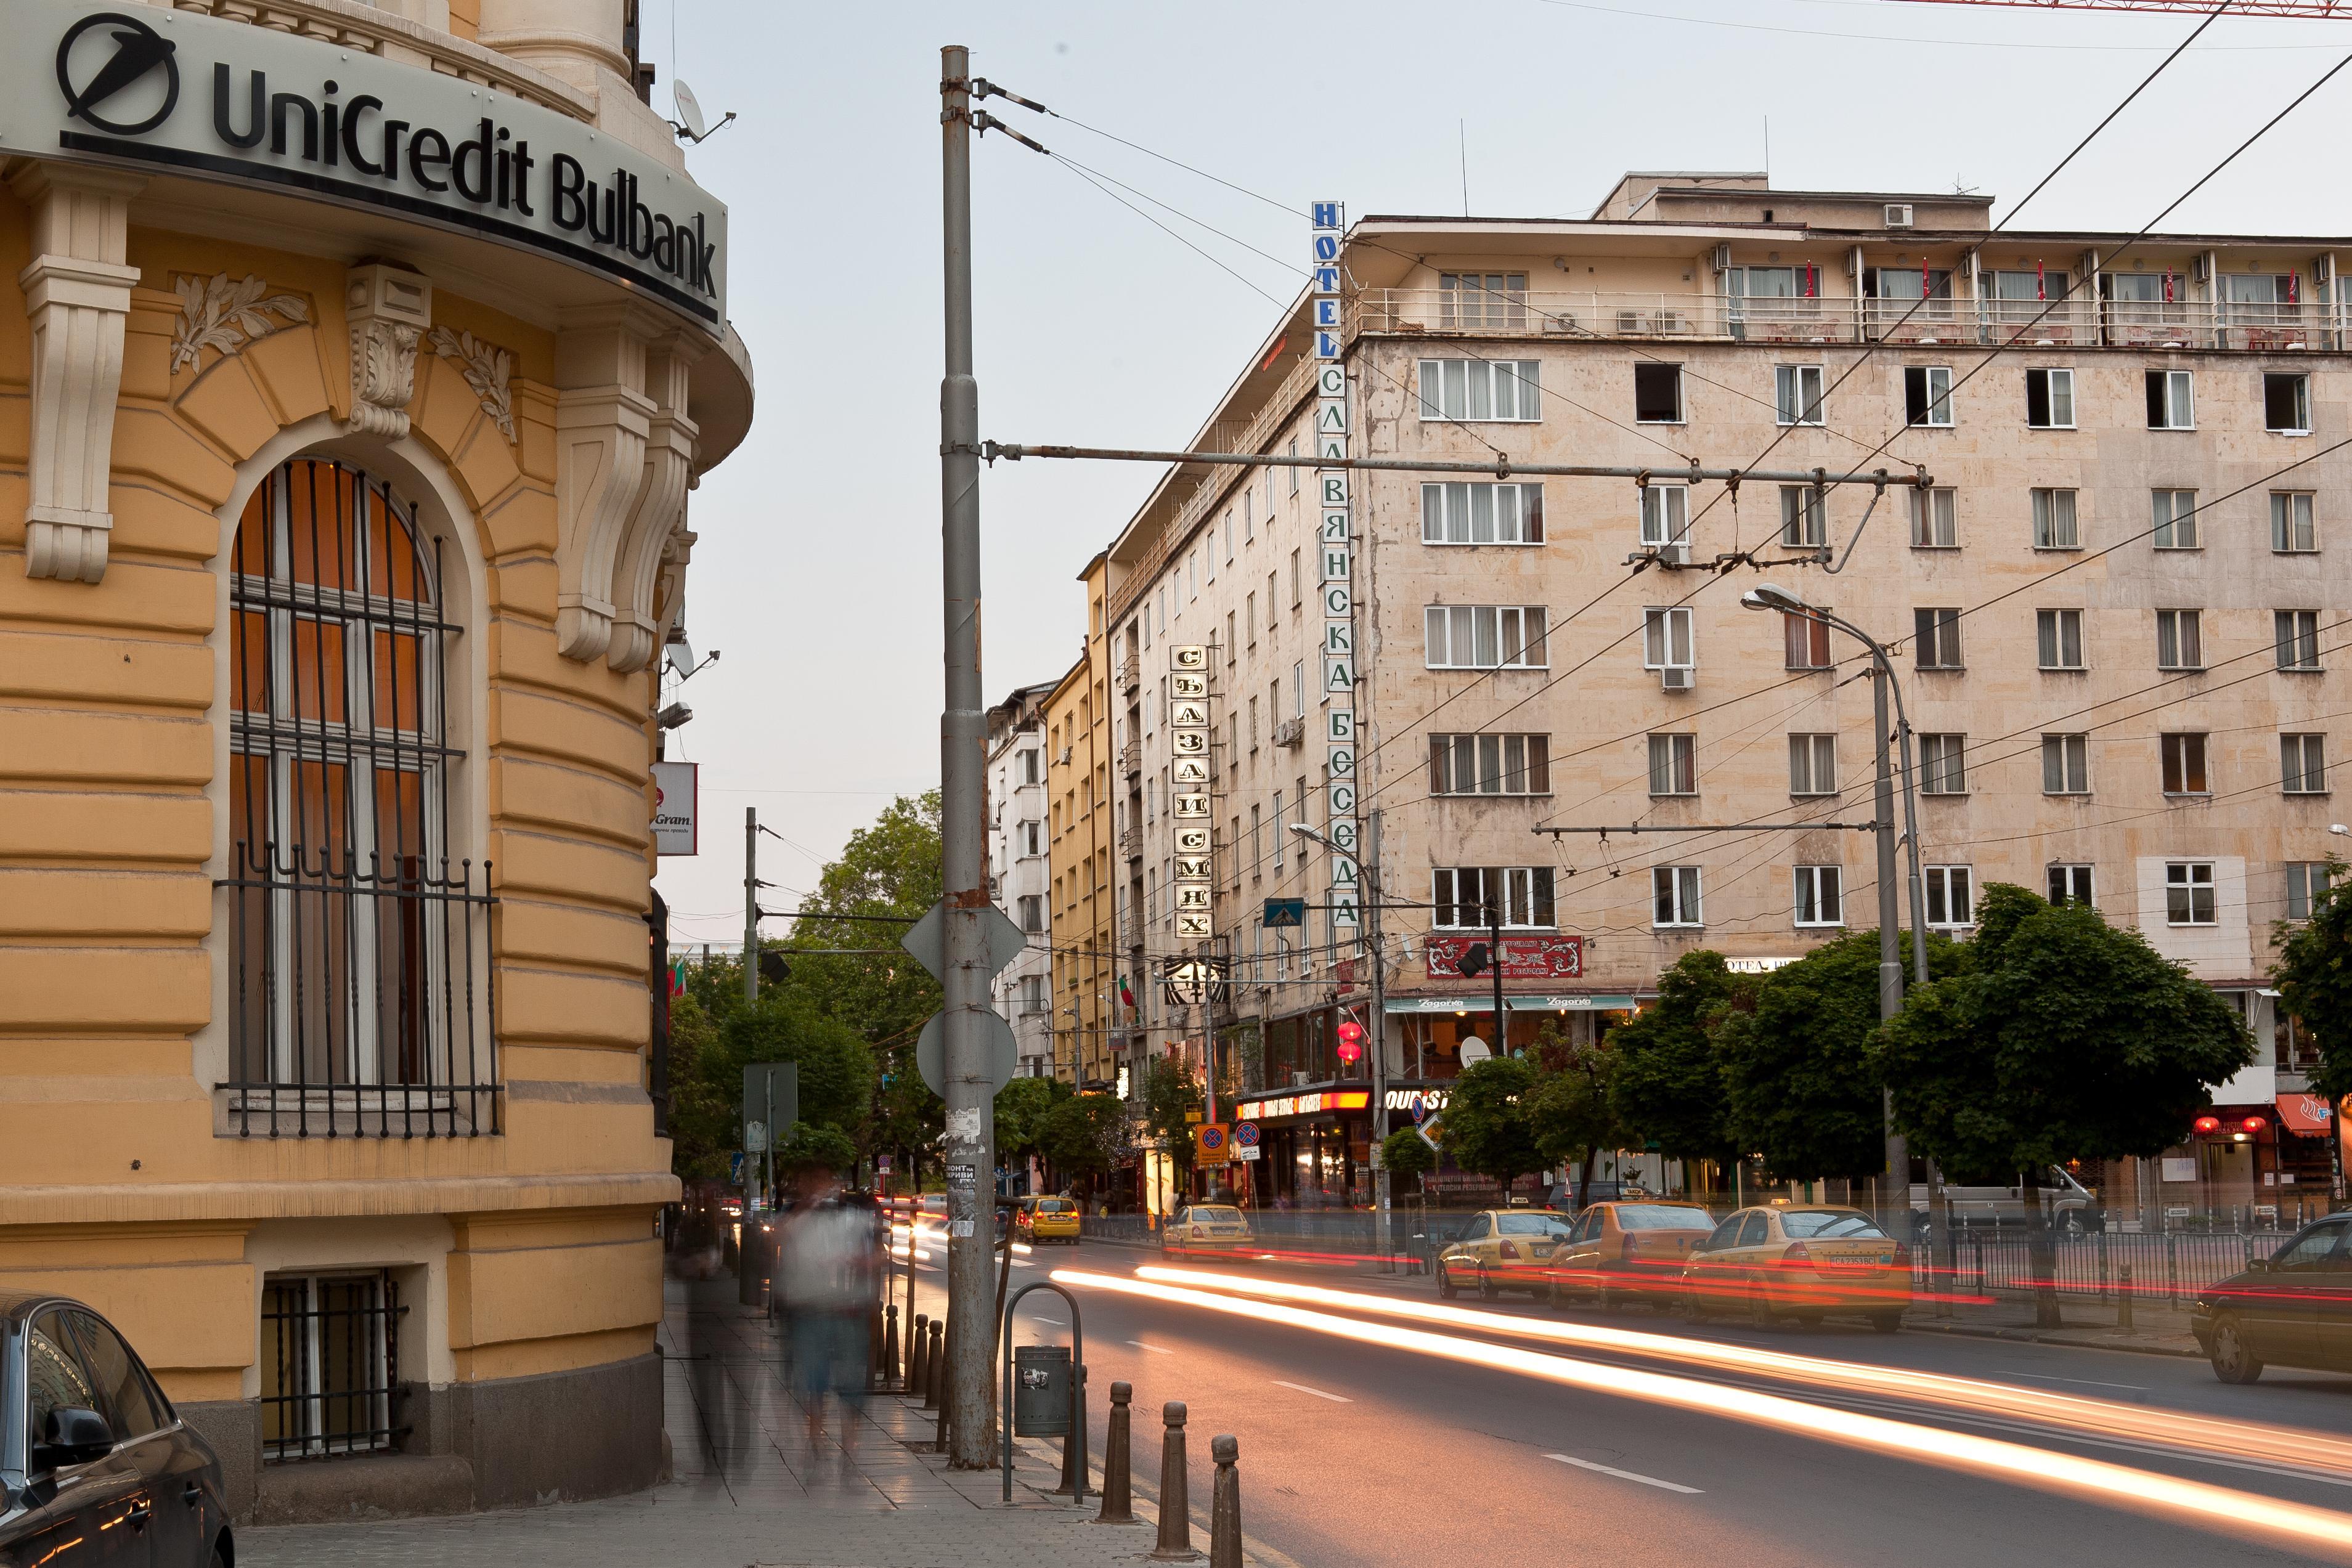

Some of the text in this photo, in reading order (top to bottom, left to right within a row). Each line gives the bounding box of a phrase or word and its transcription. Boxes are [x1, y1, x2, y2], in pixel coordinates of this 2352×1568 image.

[213, 61, 717, 299] UniCredit Bulbank
[1315, 203, 1338, 356] HOTEL
[1177, 796, 1207, 815] И
[1332, 713, 1357, 922] БЕСЕДА
[1176, 832, 1210, 935] СМЯХ
[1418, 999, 1463, 1008] Zagorka
[1547, 997, 1592, 1007] Zagorka
